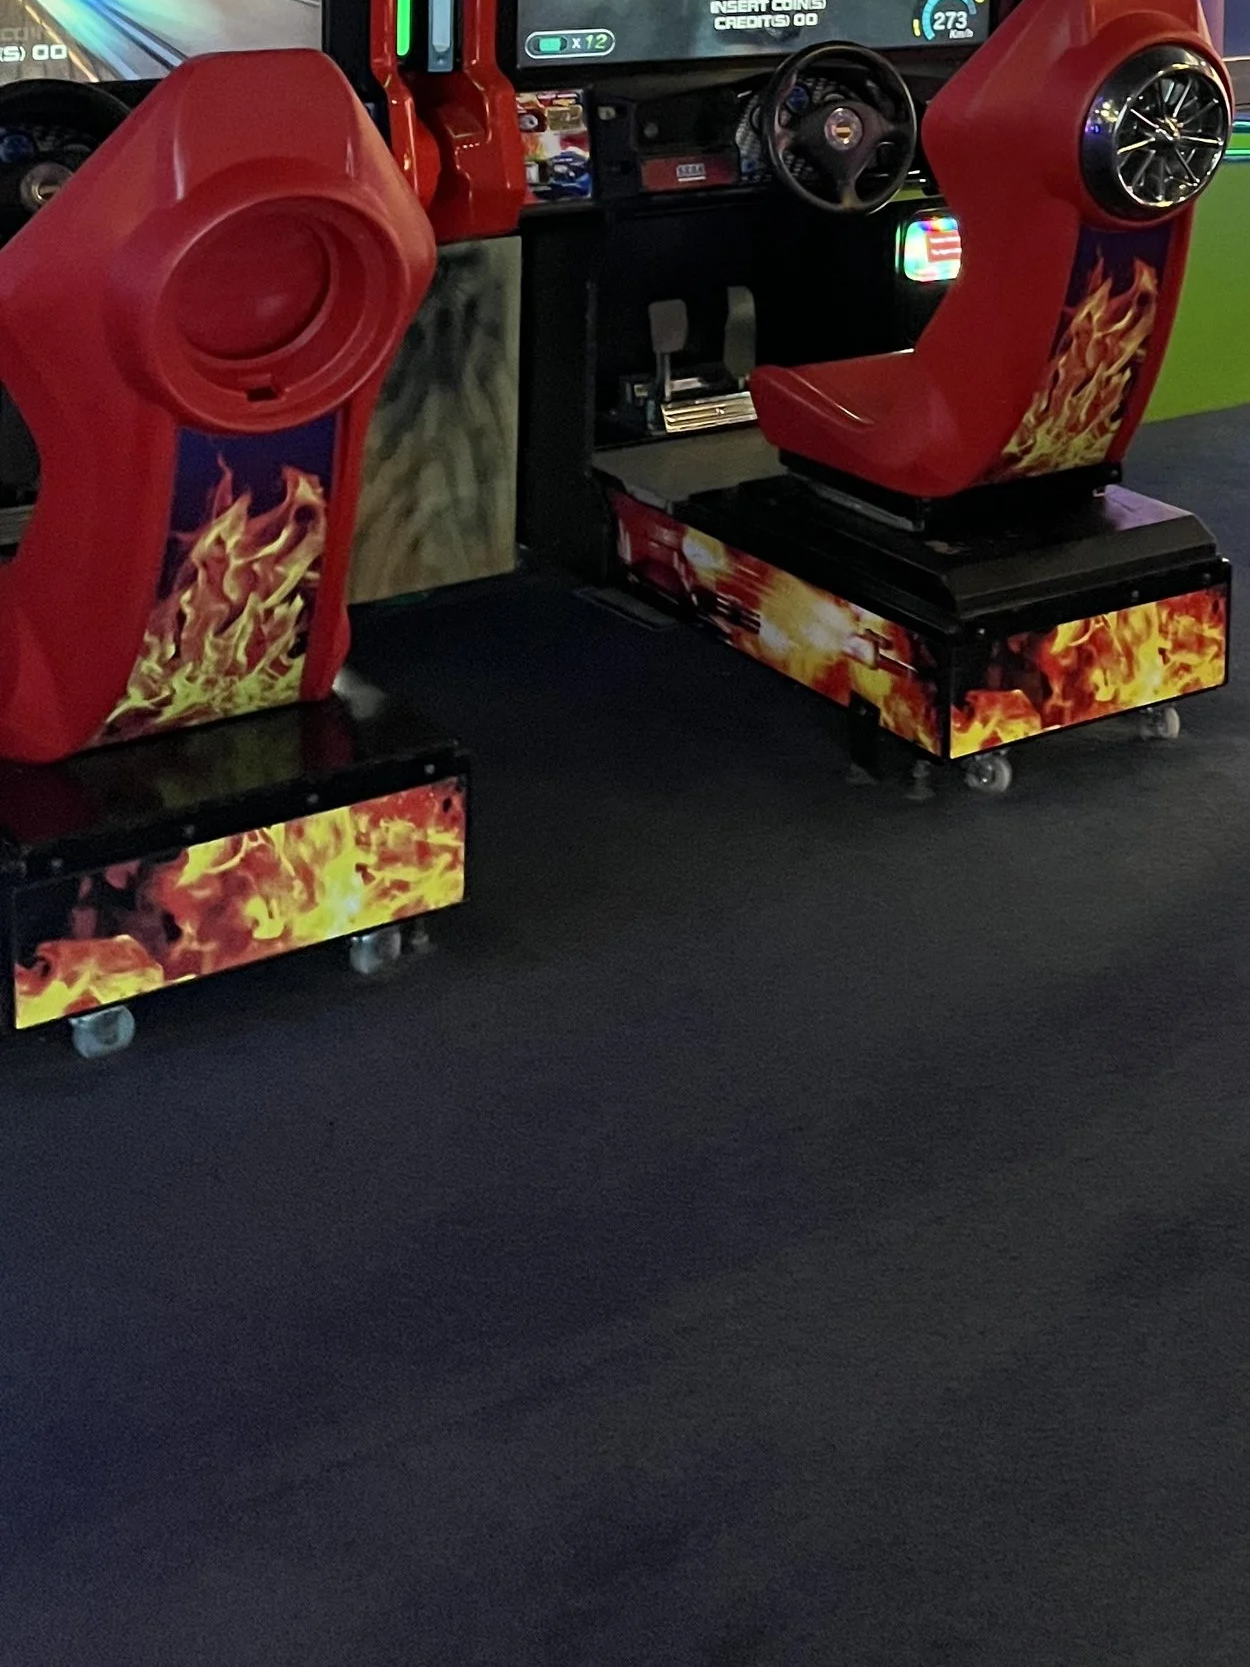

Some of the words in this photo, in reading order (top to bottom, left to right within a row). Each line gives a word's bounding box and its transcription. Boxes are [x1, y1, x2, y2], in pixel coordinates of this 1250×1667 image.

[710, 0, 769, 14] INSERT
[714, 14, 790, 30] CREDIT(S)
[793, 13, 818, 26] 00
[933, 11, 968, 30] 273
[585, 34, 608, 49] 12
[32, 44, 68, 61] 00
